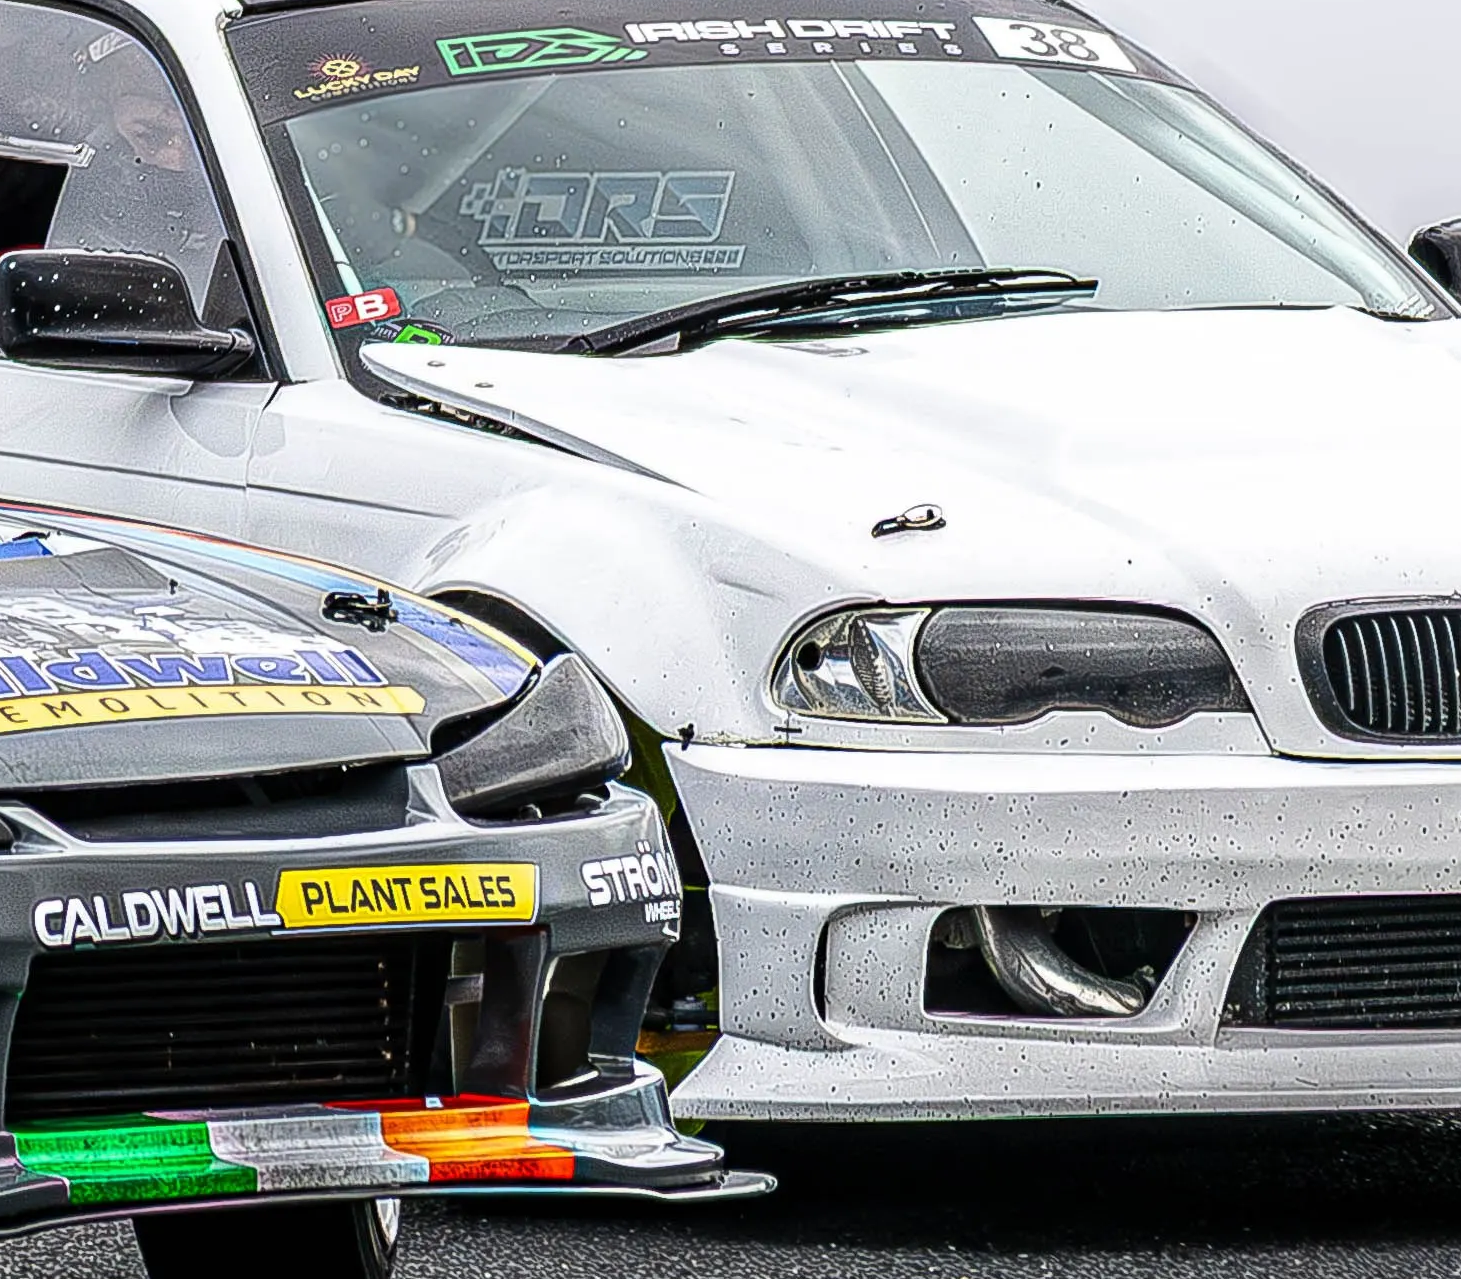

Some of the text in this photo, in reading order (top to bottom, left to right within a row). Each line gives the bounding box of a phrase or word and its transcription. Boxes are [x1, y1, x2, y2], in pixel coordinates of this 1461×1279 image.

[623, 20, 956, 43] IRISH DRIFT
[1008, 25, 1098, 61] 38
[720, 42, 964, 56] SERIES
[294, 66, 420, 99] LUCKY DAY
[506, 171, 736, 243] DRS
[34, 875, 518, 947] CALDWELL PLANT SALES
